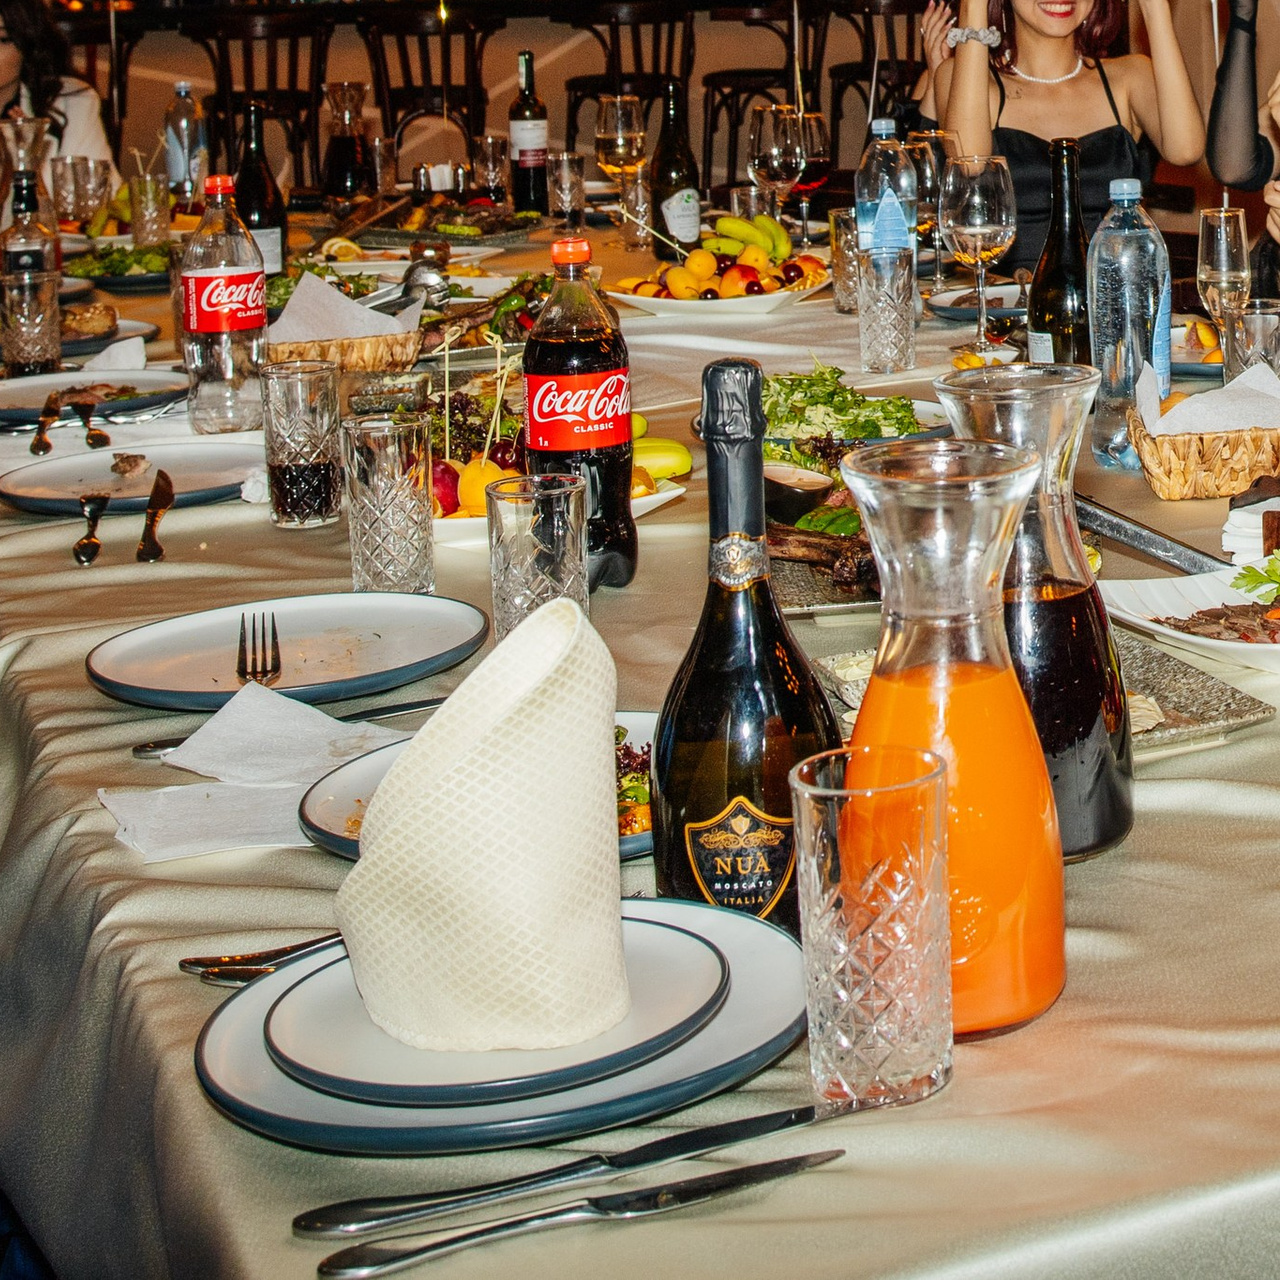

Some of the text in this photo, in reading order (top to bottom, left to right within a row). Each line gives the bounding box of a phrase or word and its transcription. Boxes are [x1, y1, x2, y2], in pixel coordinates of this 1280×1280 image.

[573, 422, 614, 433] CLASSIC
[714, 880, 773, 890] MOSCATO
[724, 895, 764, 905] ITALIA
